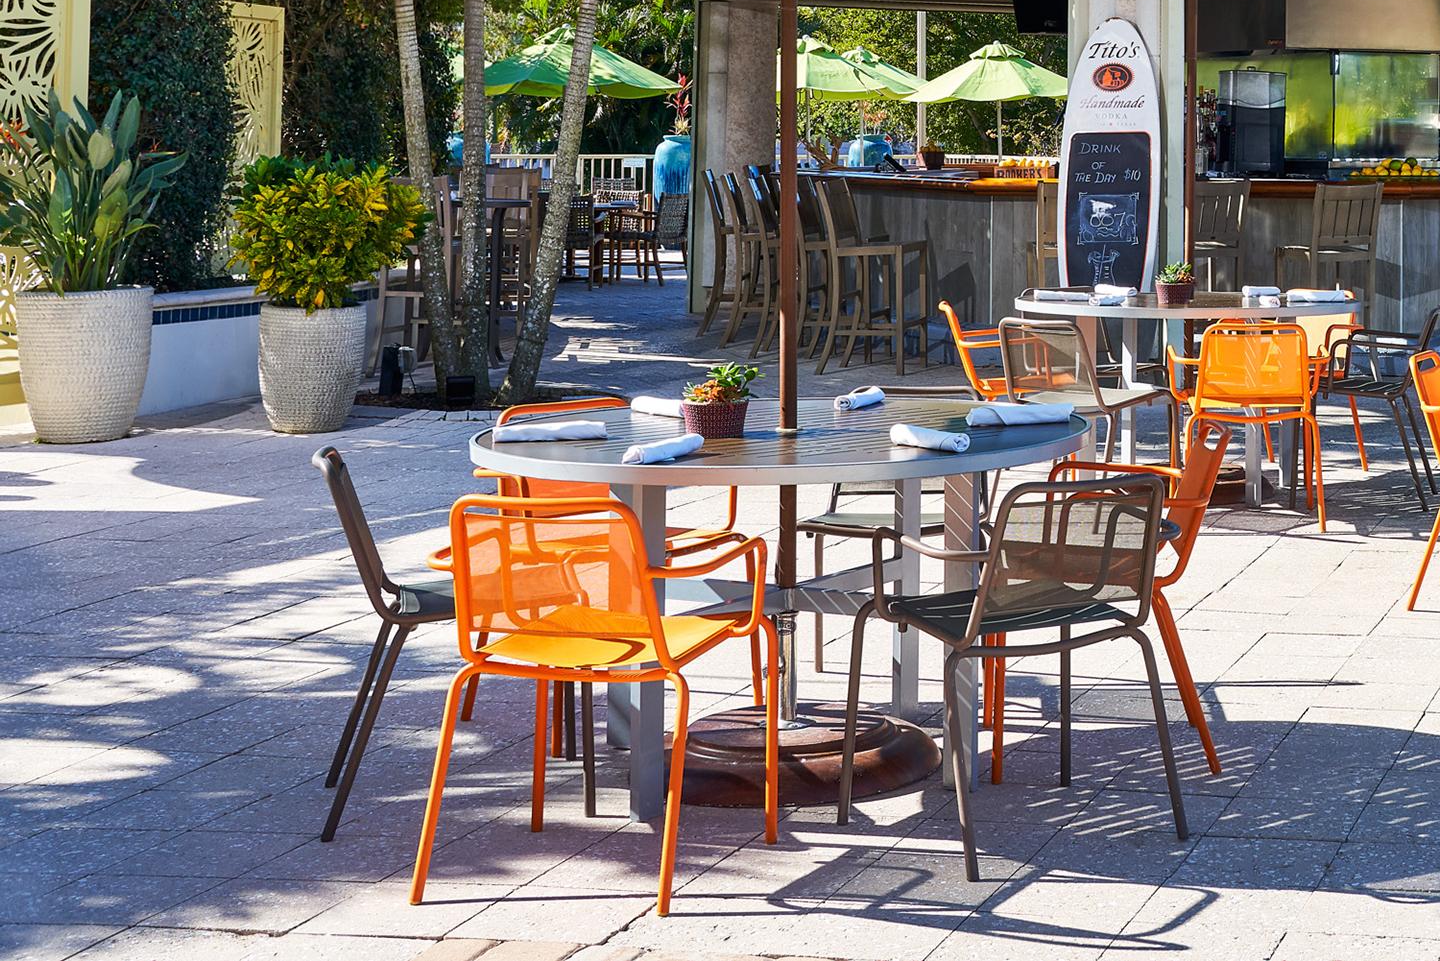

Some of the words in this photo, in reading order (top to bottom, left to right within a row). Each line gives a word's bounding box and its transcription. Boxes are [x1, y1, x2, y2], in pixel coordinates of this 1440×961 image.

[1088, 41, 1140, 59] Tito's
[1080, 95, 1145, 109] Handmade
[1080, 142, 1120, 154] DRINK
[1123, 168, 1141, 181] $10
